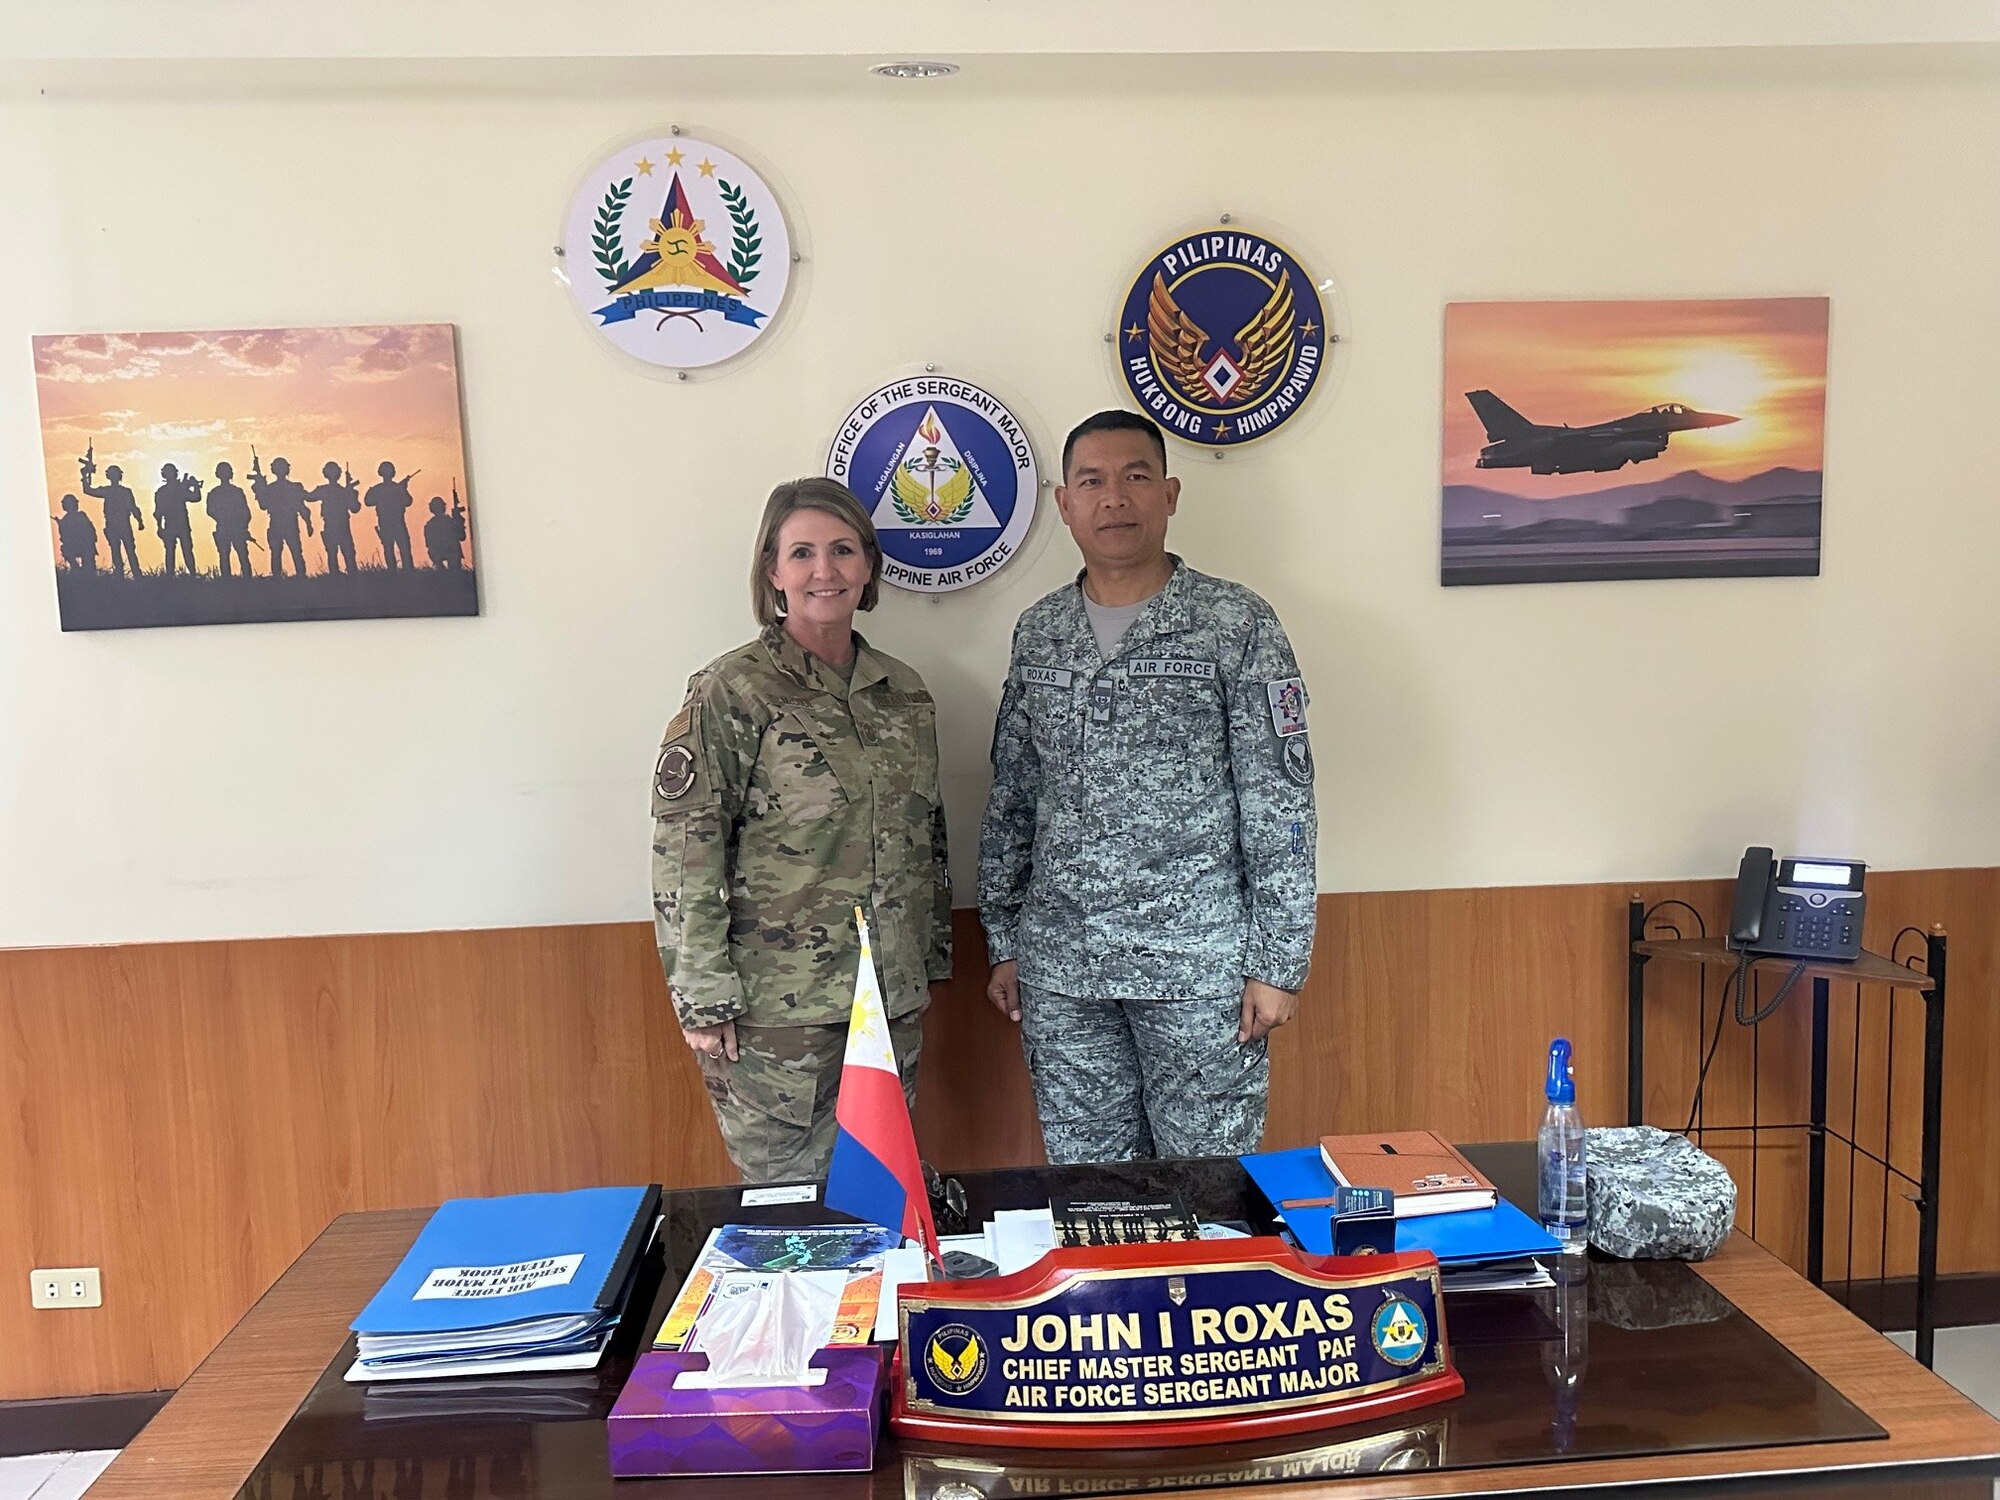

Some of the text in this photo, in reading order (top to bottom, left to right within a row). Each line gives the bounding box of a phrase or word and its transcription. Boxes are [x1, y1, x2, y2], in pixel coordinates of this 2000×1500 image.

[1162, 236, 1282, 276] PILIPINAS
[624, 294, 738, 312] PHILIPPINES
[1130, 345, 1318, 435] HUKBONG HIMPAPAWID
[834, 381, 1030, 476] OFFICE OF THE SERGEANT MAJOR
[874, 442, 906, 493] KAGALINGAN
[964, 450, 988, 487] DISIPLINA
[909, 531, 961, 539] KASIGLAHAN
[882, 541, 1012, 587] IPPINE AIR FORCE
[924, 548, 943, 556] 1969
[1027, 669, 1057, 683] ROXAS
[1133, 662, 1212, 676] AIR FORCE
[432, 1265, 568, 1287] SERGEANT MAJOR
[458, 1259, 555, 1277] CLEAR BOOK
[452, 1280, 537, 1297] AIR FORCE
[937, 1328, 970, 1340] PILIPINAS
[1001, 1312, 1142, 1352] JOHN
[1158, 1311, 1174, 1349] I
[1191, 1293, 1354, 1346] ROXAS
[1002, 1336, 1356, 1380] CHIEF MASTER SERGEANT PAF
[1005, 1362, 1361, 1407] AIR FORCE SERGEANT MAJOR
